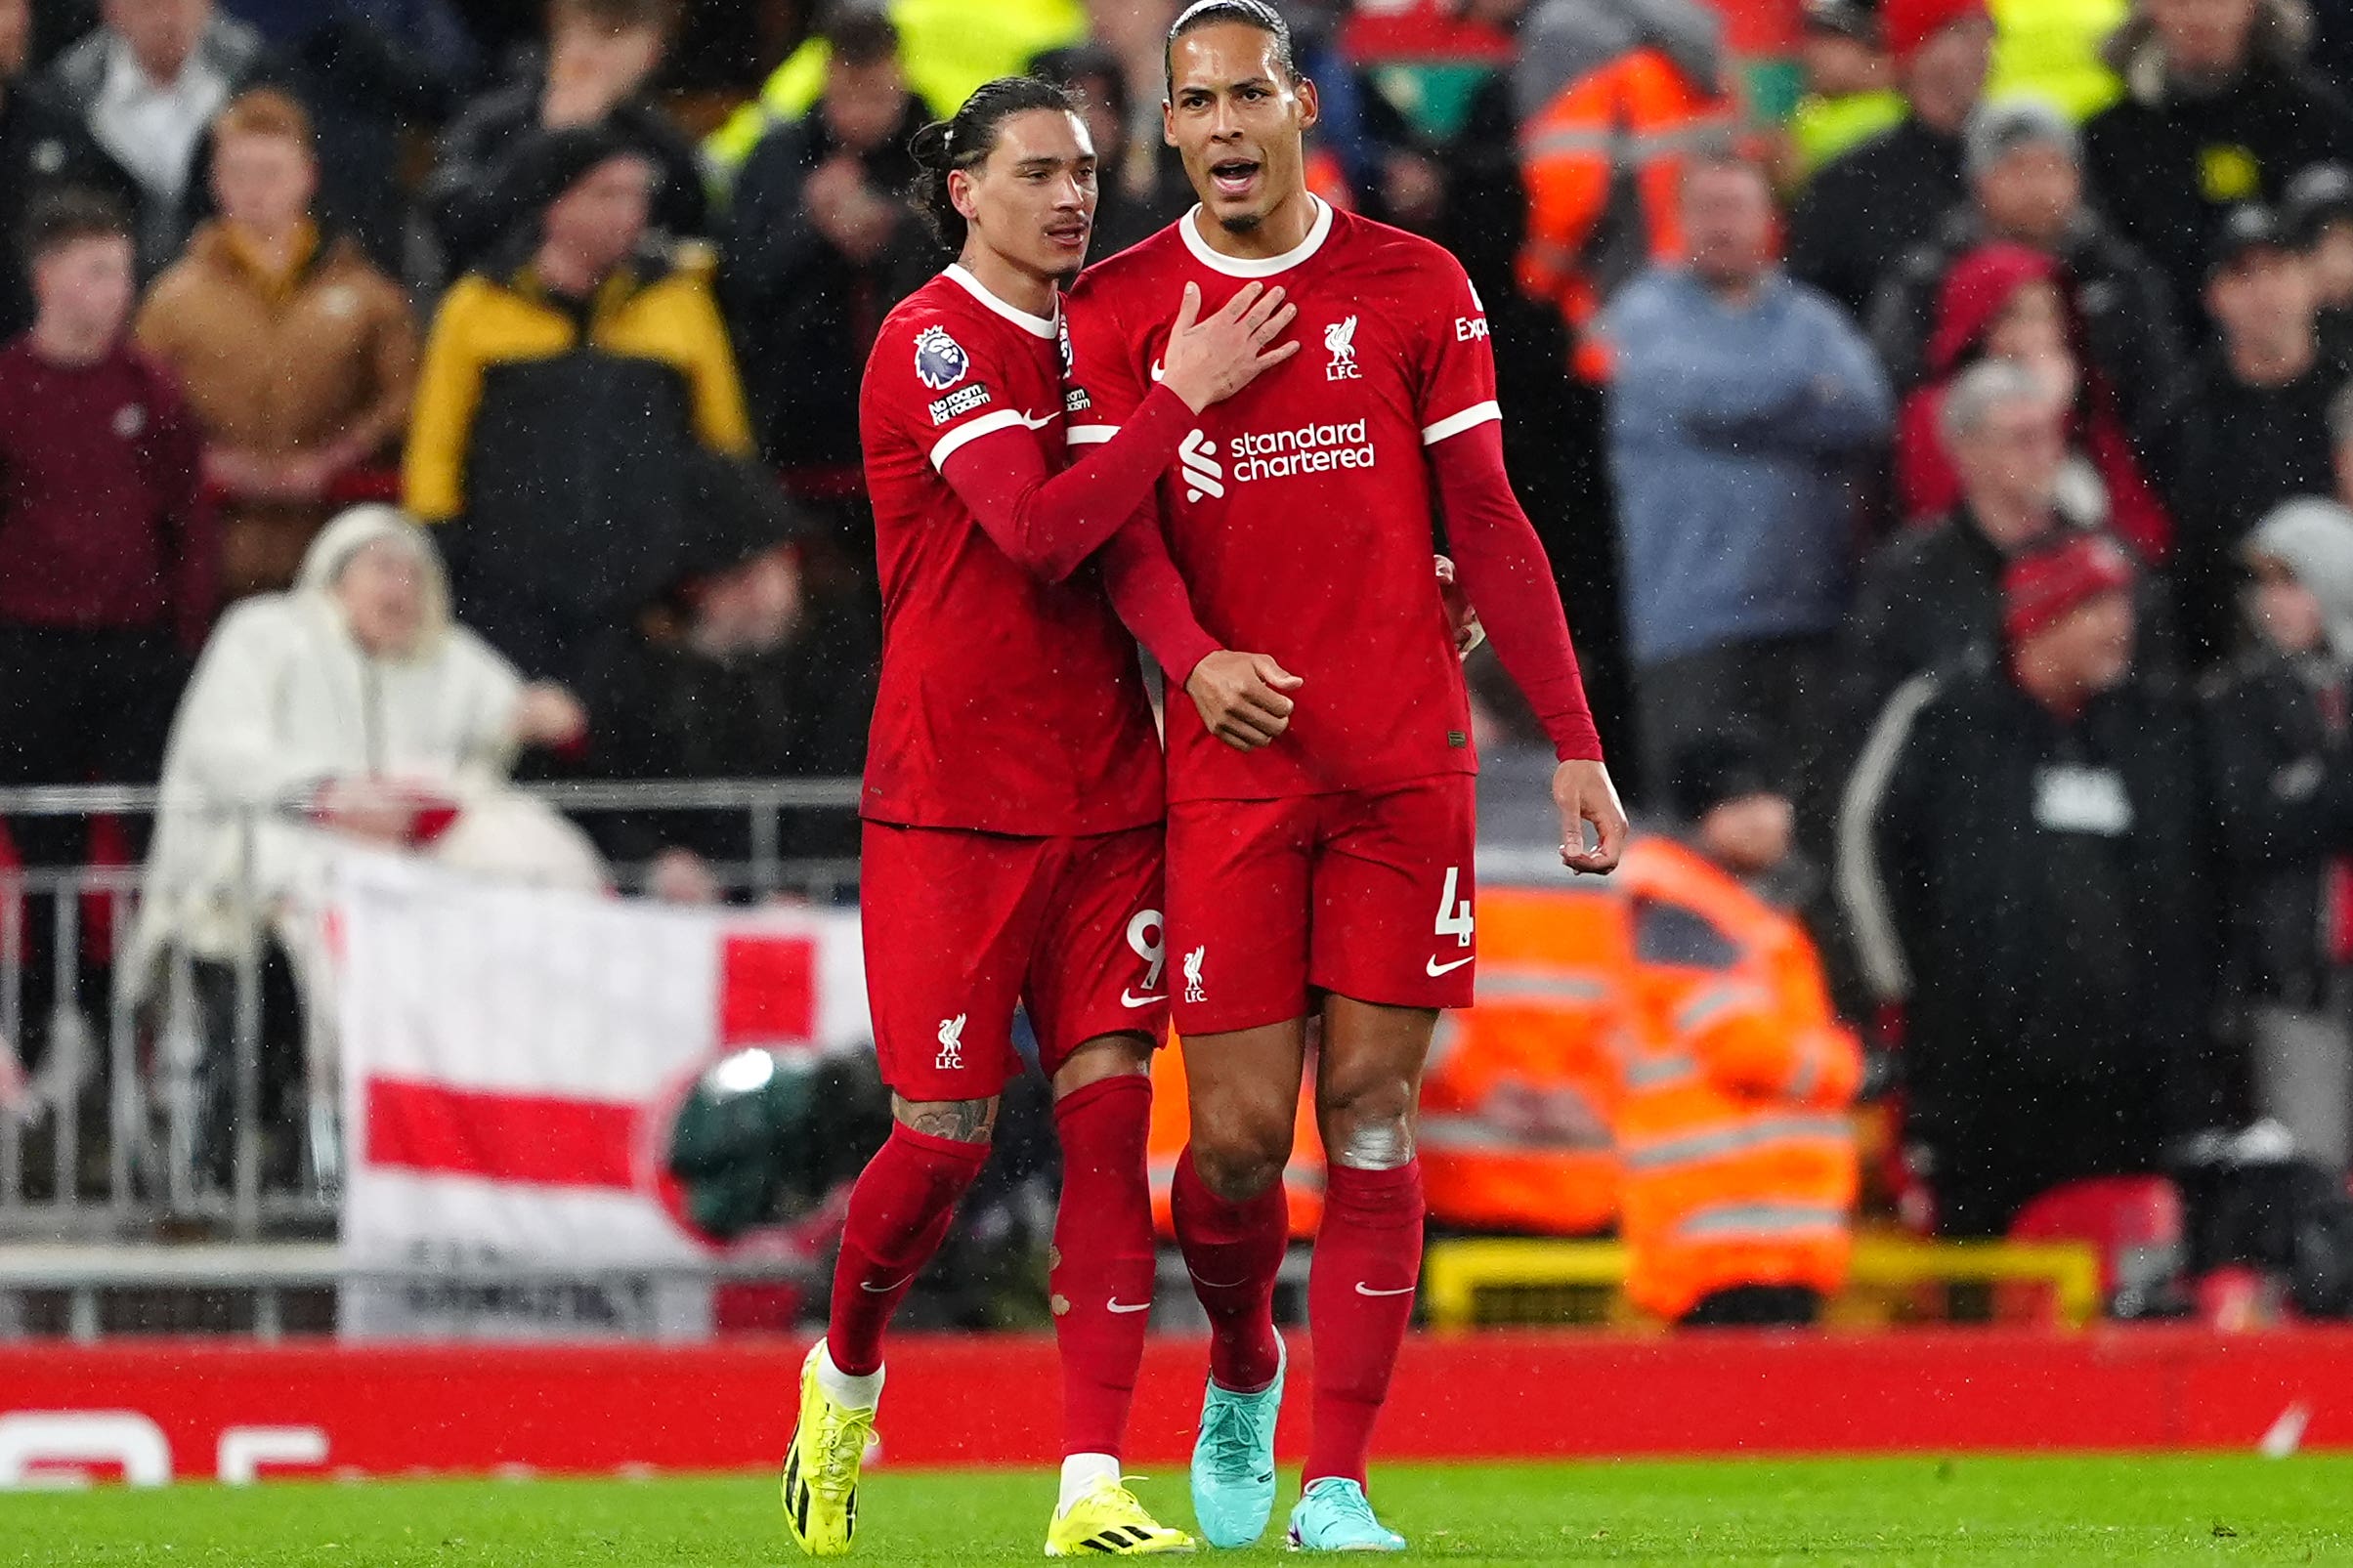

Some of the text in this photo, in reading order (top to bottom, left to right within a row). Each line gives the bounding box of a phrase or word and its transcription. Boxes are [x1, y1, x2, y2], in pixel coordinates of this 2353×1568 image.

[928, 384, 983, 414] No room
[931, 392, 992, 426] for racism
[1230, 418, 1366, 458] standard
[1233, 443, 1375, 482] chartered
[1434, 867, 1475, 948] 4
[1127, 909, 1166, 991] 9
